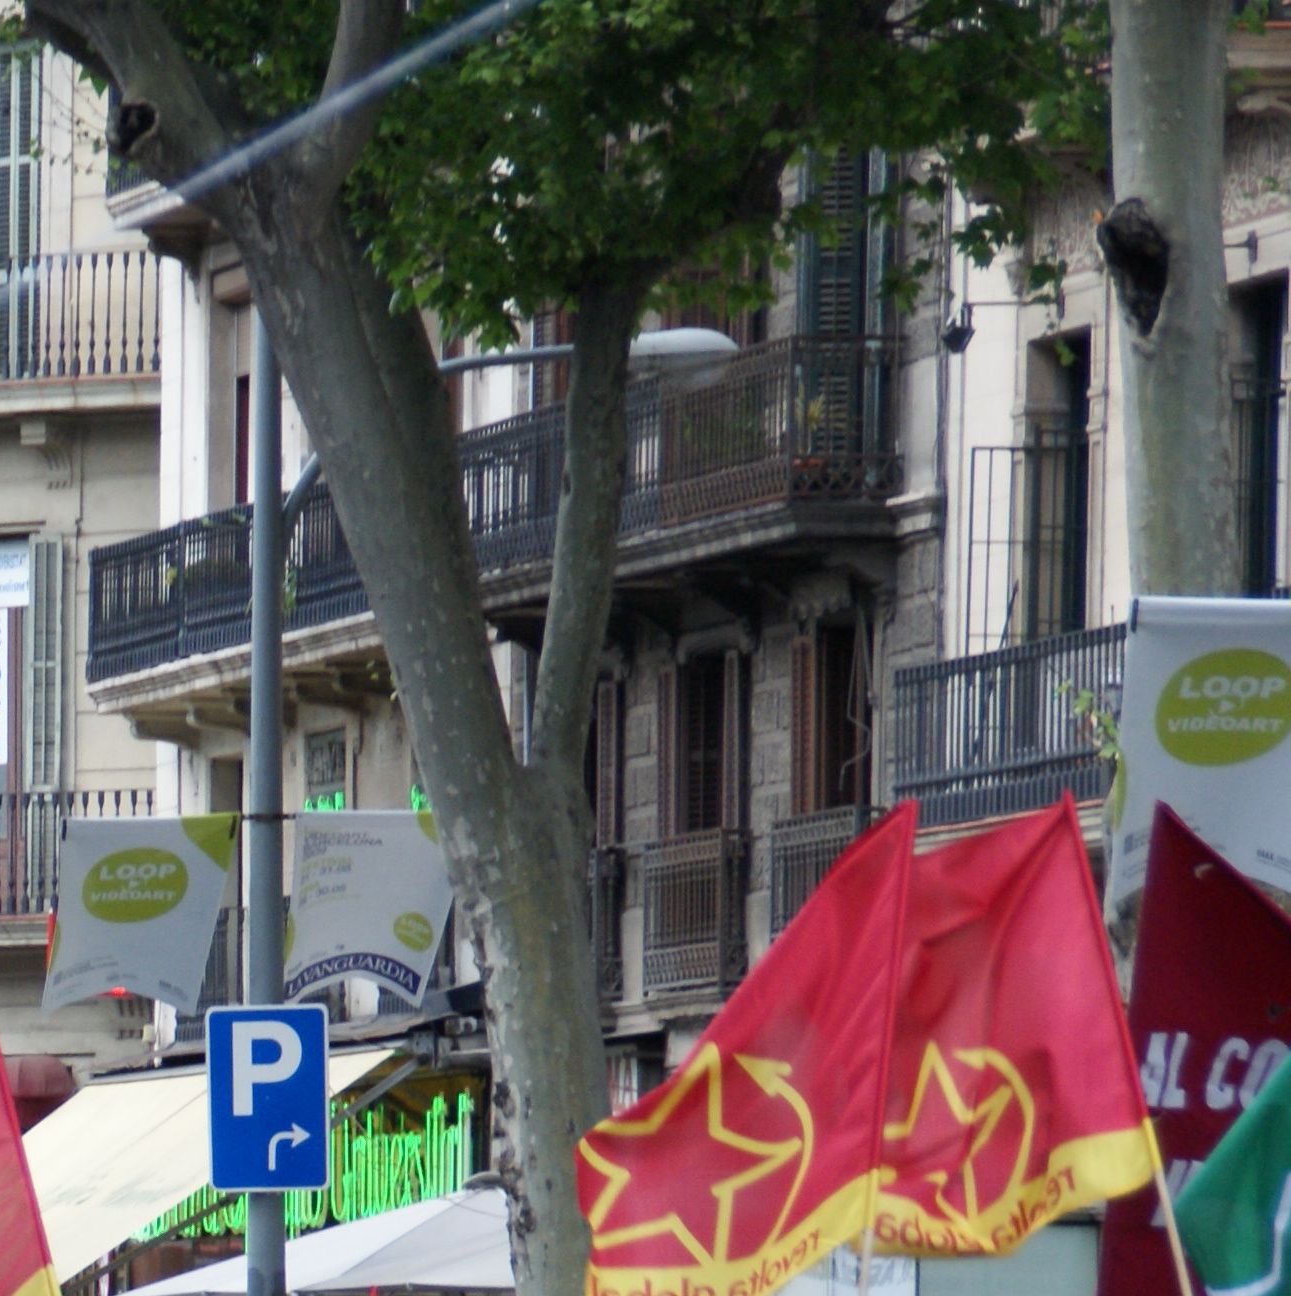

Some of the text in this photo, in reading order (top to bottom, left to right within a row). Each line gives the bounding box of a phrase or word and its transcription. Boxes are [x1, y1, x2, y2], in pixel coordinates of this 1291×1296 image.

[1179, 674, 1285, 699] LOOP
[100, 863, 177, 882] LOOP
[302, 953, 415, 991] VANGUARDIA
